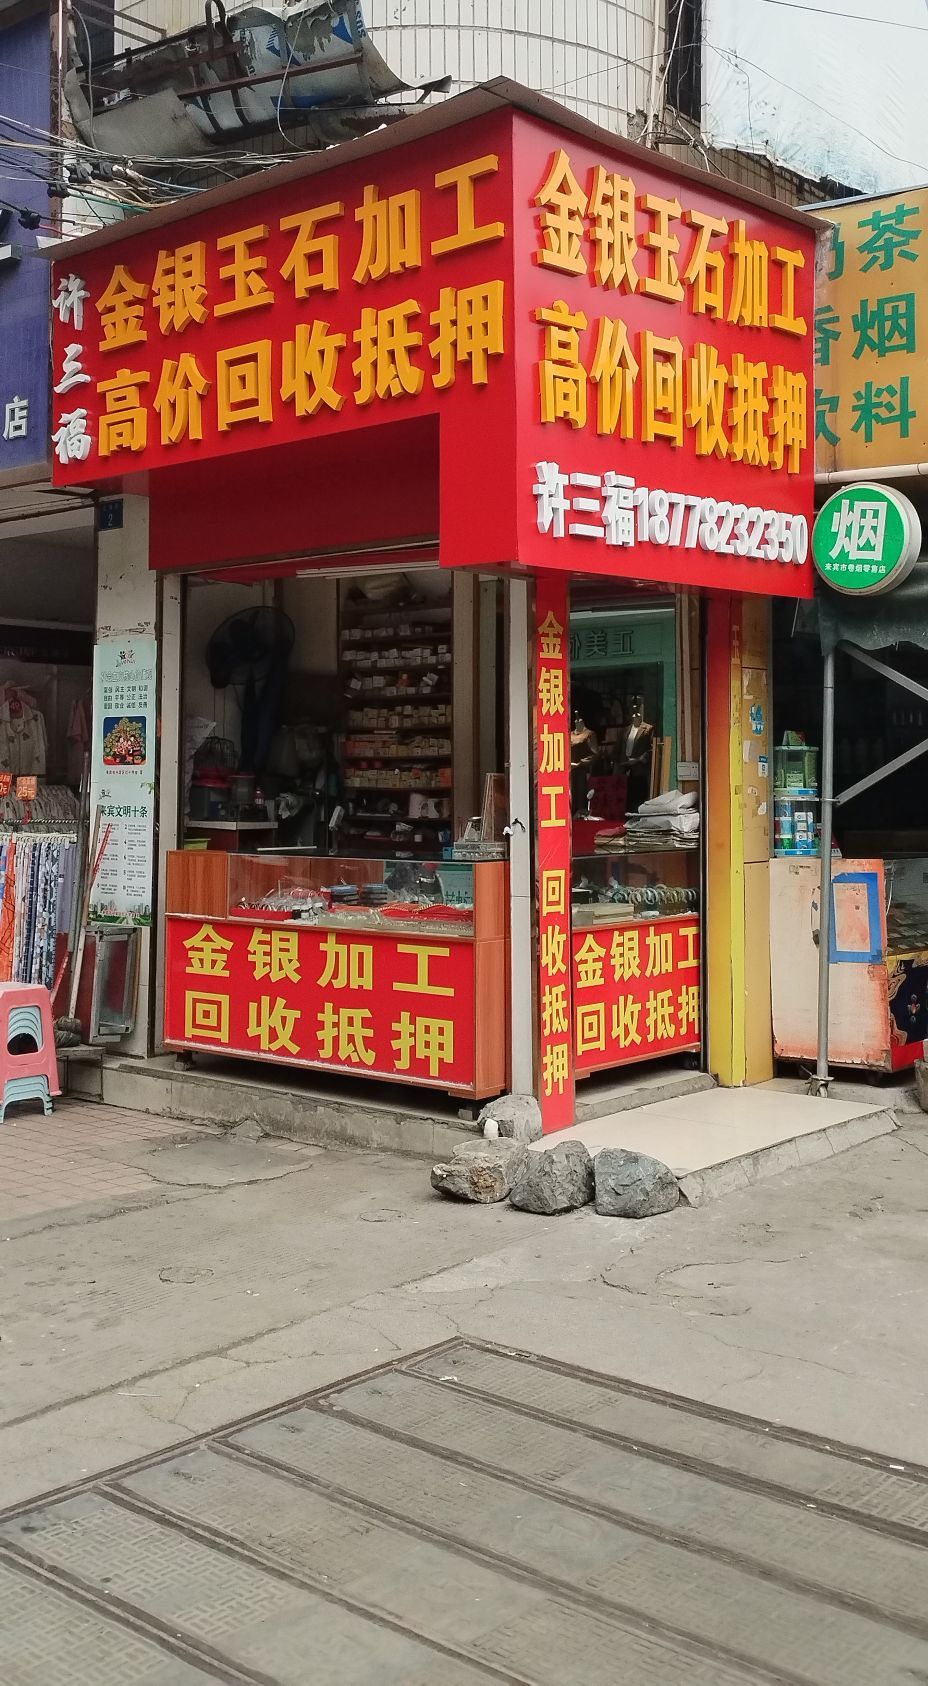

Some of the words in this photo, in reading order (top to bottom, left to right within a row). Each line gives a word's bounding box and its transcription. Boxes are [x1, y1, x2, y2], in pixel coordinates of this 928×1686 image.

[95, 154, 505, 352] 金银玉石加工
[534, 148, 808, 338] 金银玉石加工
[3, 396, 29, 441] 店
[51, 273, 92, 465] 许三福
[96, 280, 505, 457] 高价回收抵押
[535, 300, 808, 474] 高价回收抵押
[828, 499, 888, 561] 烟
[538, 610, 566, 828] 金银加工
[182, 924, 455, 998] 金银加工
[184, 990, 455, 1078] 回收抵押
[541, 869, 569, 1097] 回收抵押
[574, 926, 700, 989] 金银加工
[576, 985, 701, 1057] 回收抵押
